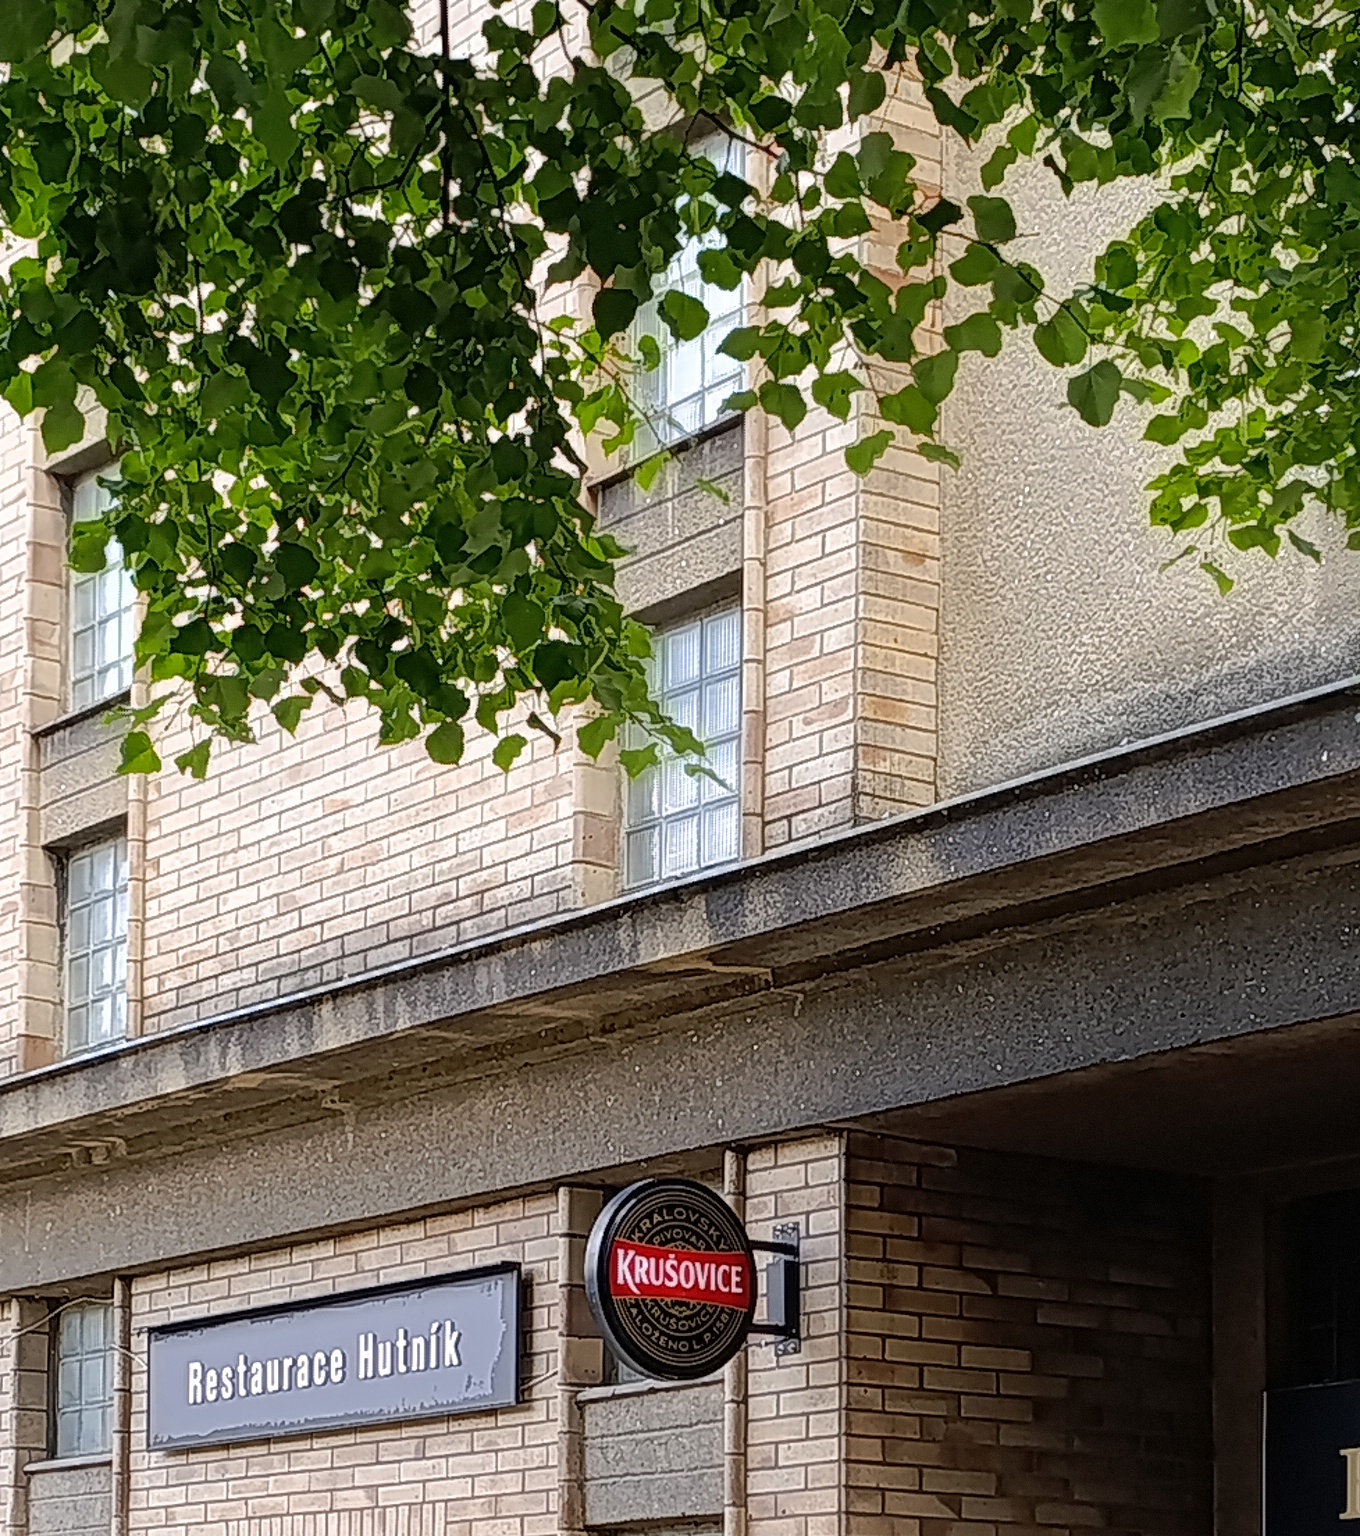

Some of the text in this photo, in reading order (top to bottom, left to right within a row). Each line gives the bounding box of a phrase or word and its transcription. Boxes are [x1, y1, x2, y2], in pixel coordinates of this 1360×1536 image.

[653, 1228, 706, 1250] PIVOVAR
[617, 1248, 743, 1295] KRUŠOVICE
[645, 1298, 715, 1330] KRUŠOVICE
[188, 1319, 462, 1405] Restaurace Hutník
